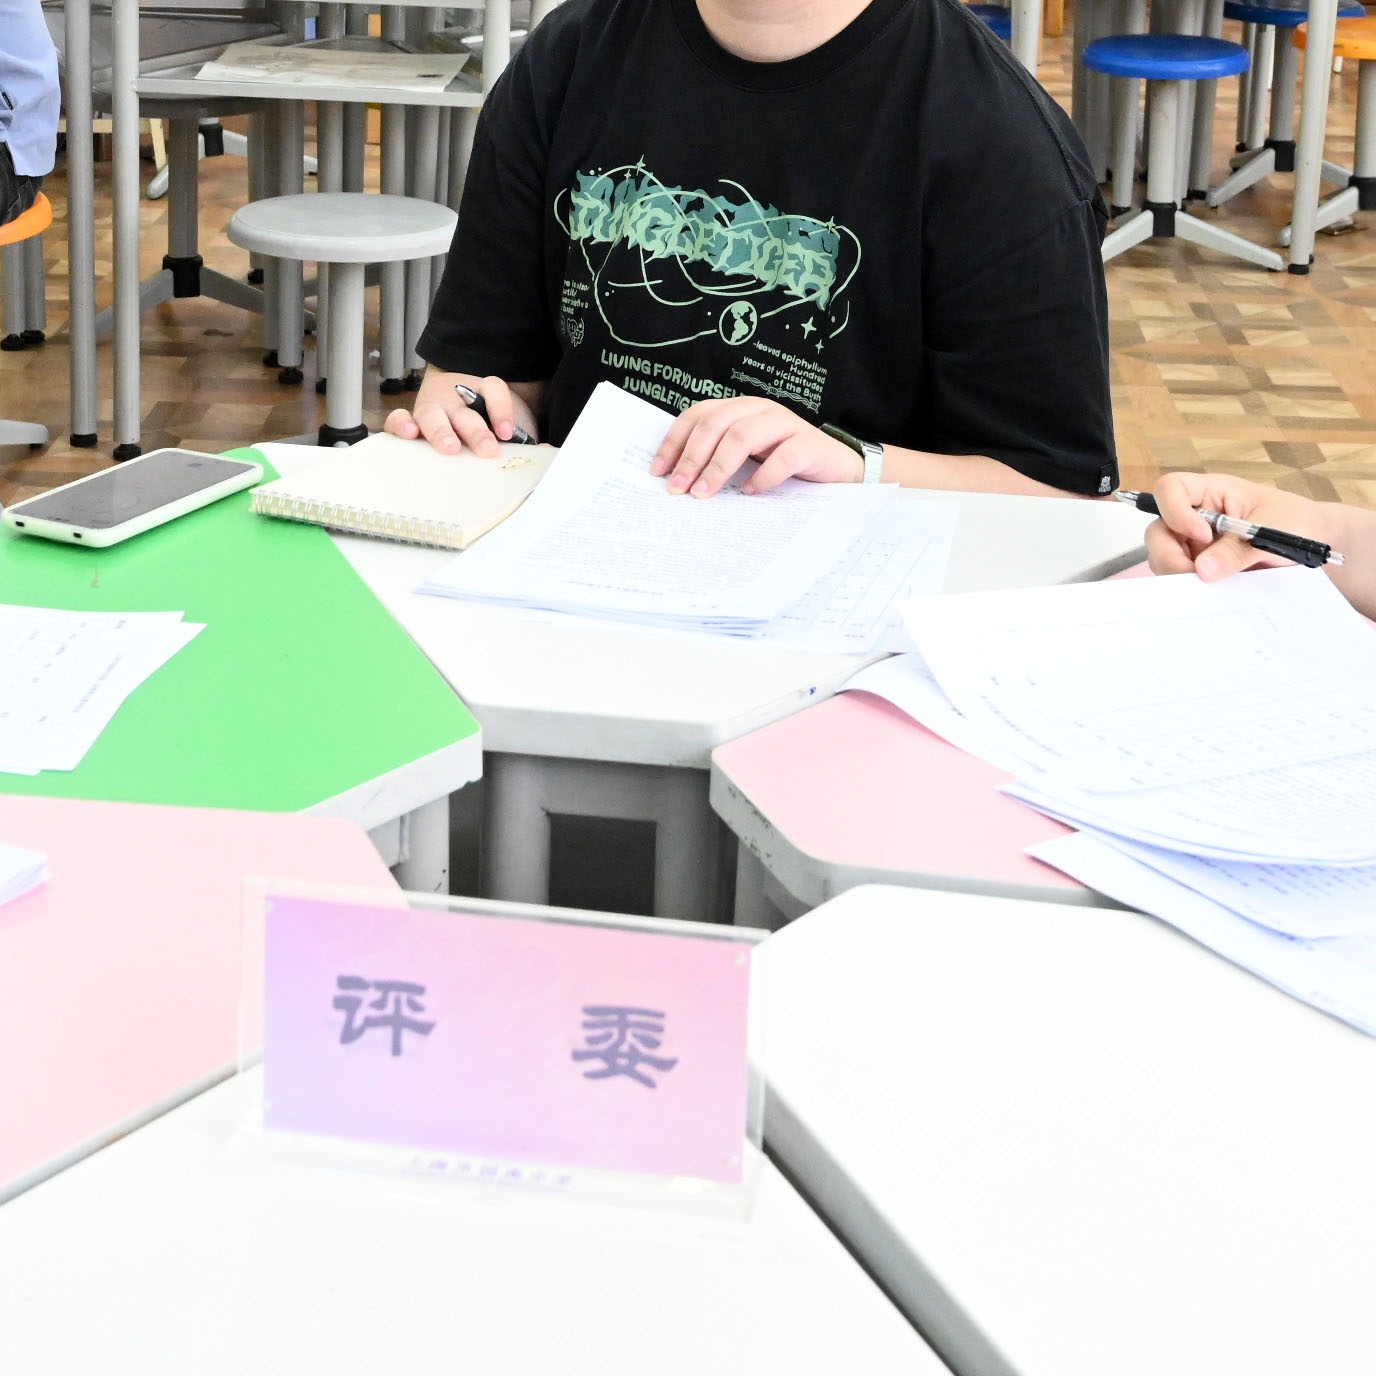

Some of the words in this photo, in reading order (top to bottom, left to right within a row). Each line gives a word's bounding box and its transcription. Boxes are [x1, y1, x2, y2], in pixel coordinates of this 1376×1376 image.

[600, 348, 652, 375] LIVING
[680, 371, 747, 399] YOURSEL
[742, 356, 766, 371] years
[766, 366, 775, 375] of
[776, 370, 824, 393] vicissitudes
[781, 352, 828, 376] epiphyllum
[789, 364, 827, 385] Hundred
[623, 376, 700, 412] JUNGLETIG
[773, 378, 784, 388] of
[786, 383, 802, 394] the
[803, 387, 822, 402] Bush
[332, 974, 680, 1090] 评委
